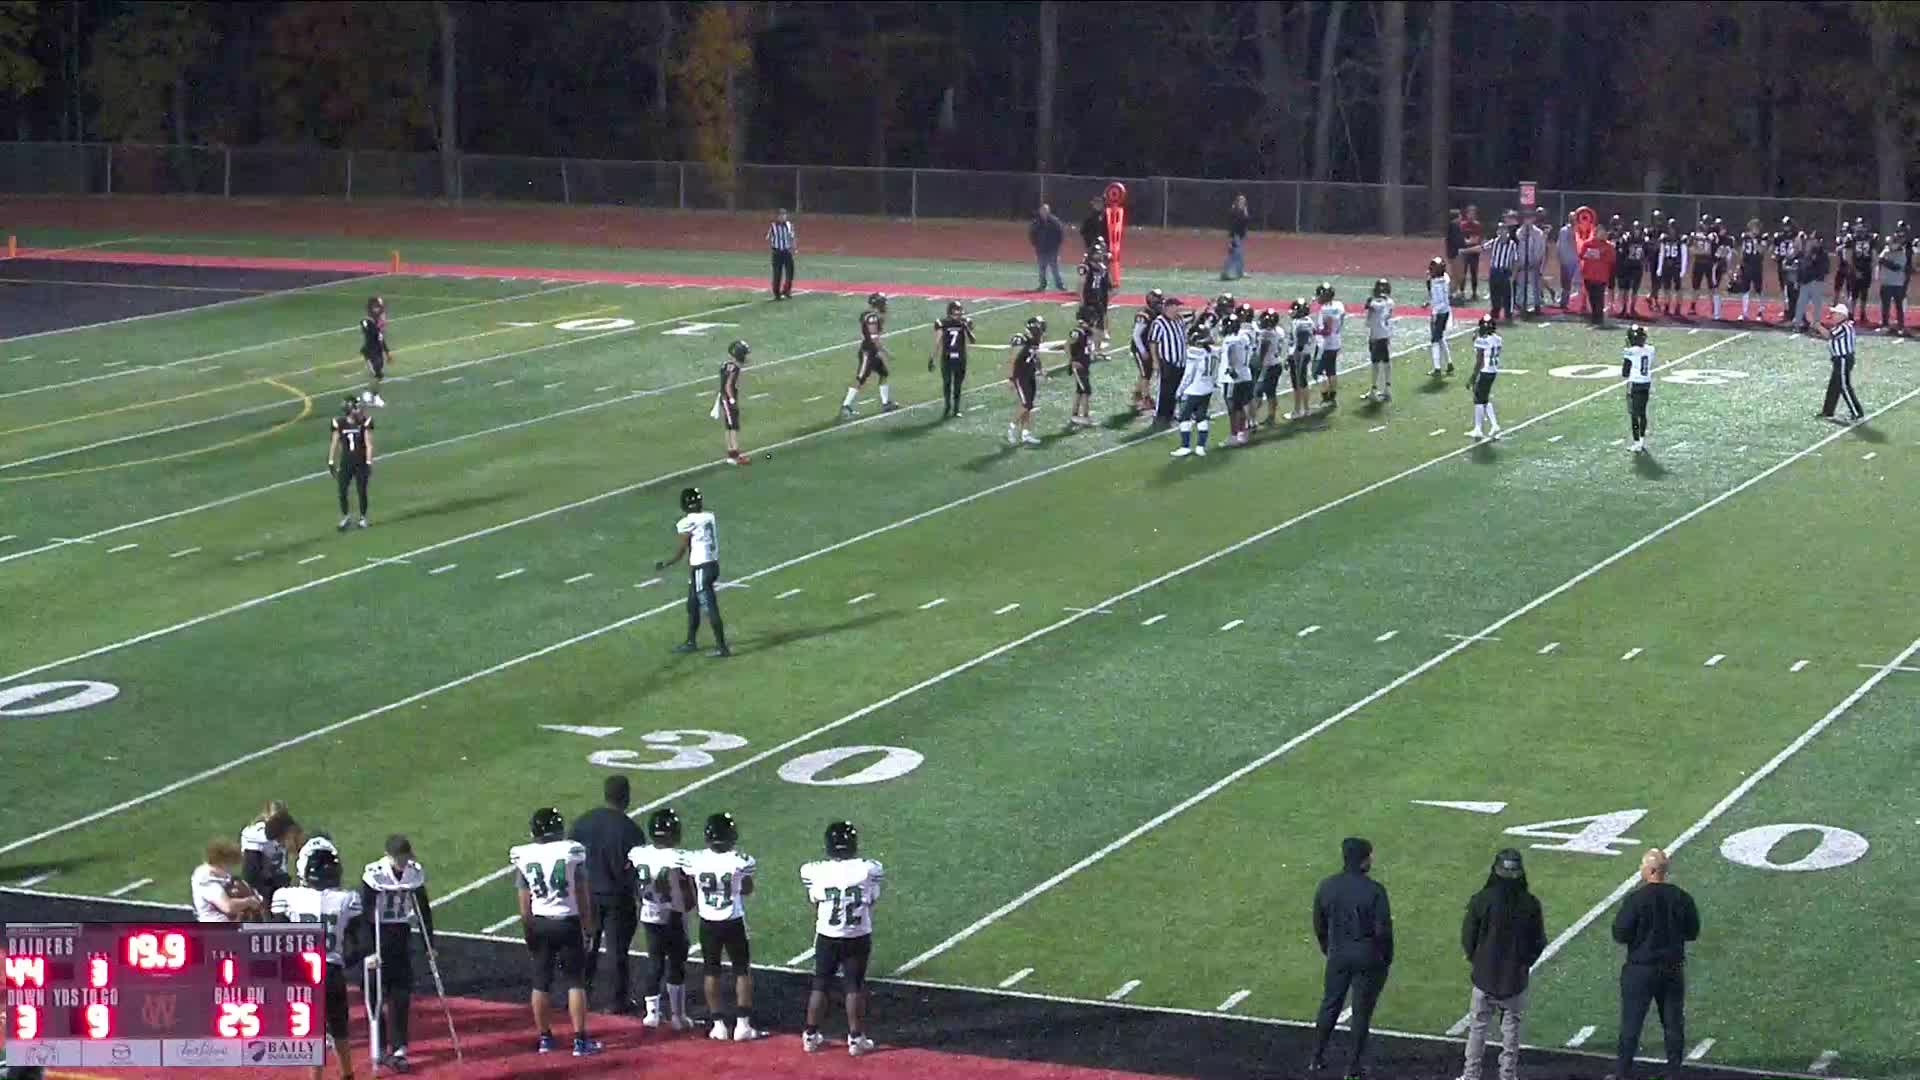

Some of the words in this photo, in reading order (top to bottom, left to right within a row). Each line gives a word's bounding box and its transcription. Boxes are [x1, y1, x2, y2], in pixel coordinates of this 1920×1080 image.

[949, 330, 959, 346] 7
[346, 433, 354, 451] 1
[526, 858, 567, 899] 34
[698, 871, 733, 909] 21
[824, 885, 863, 926] 72
